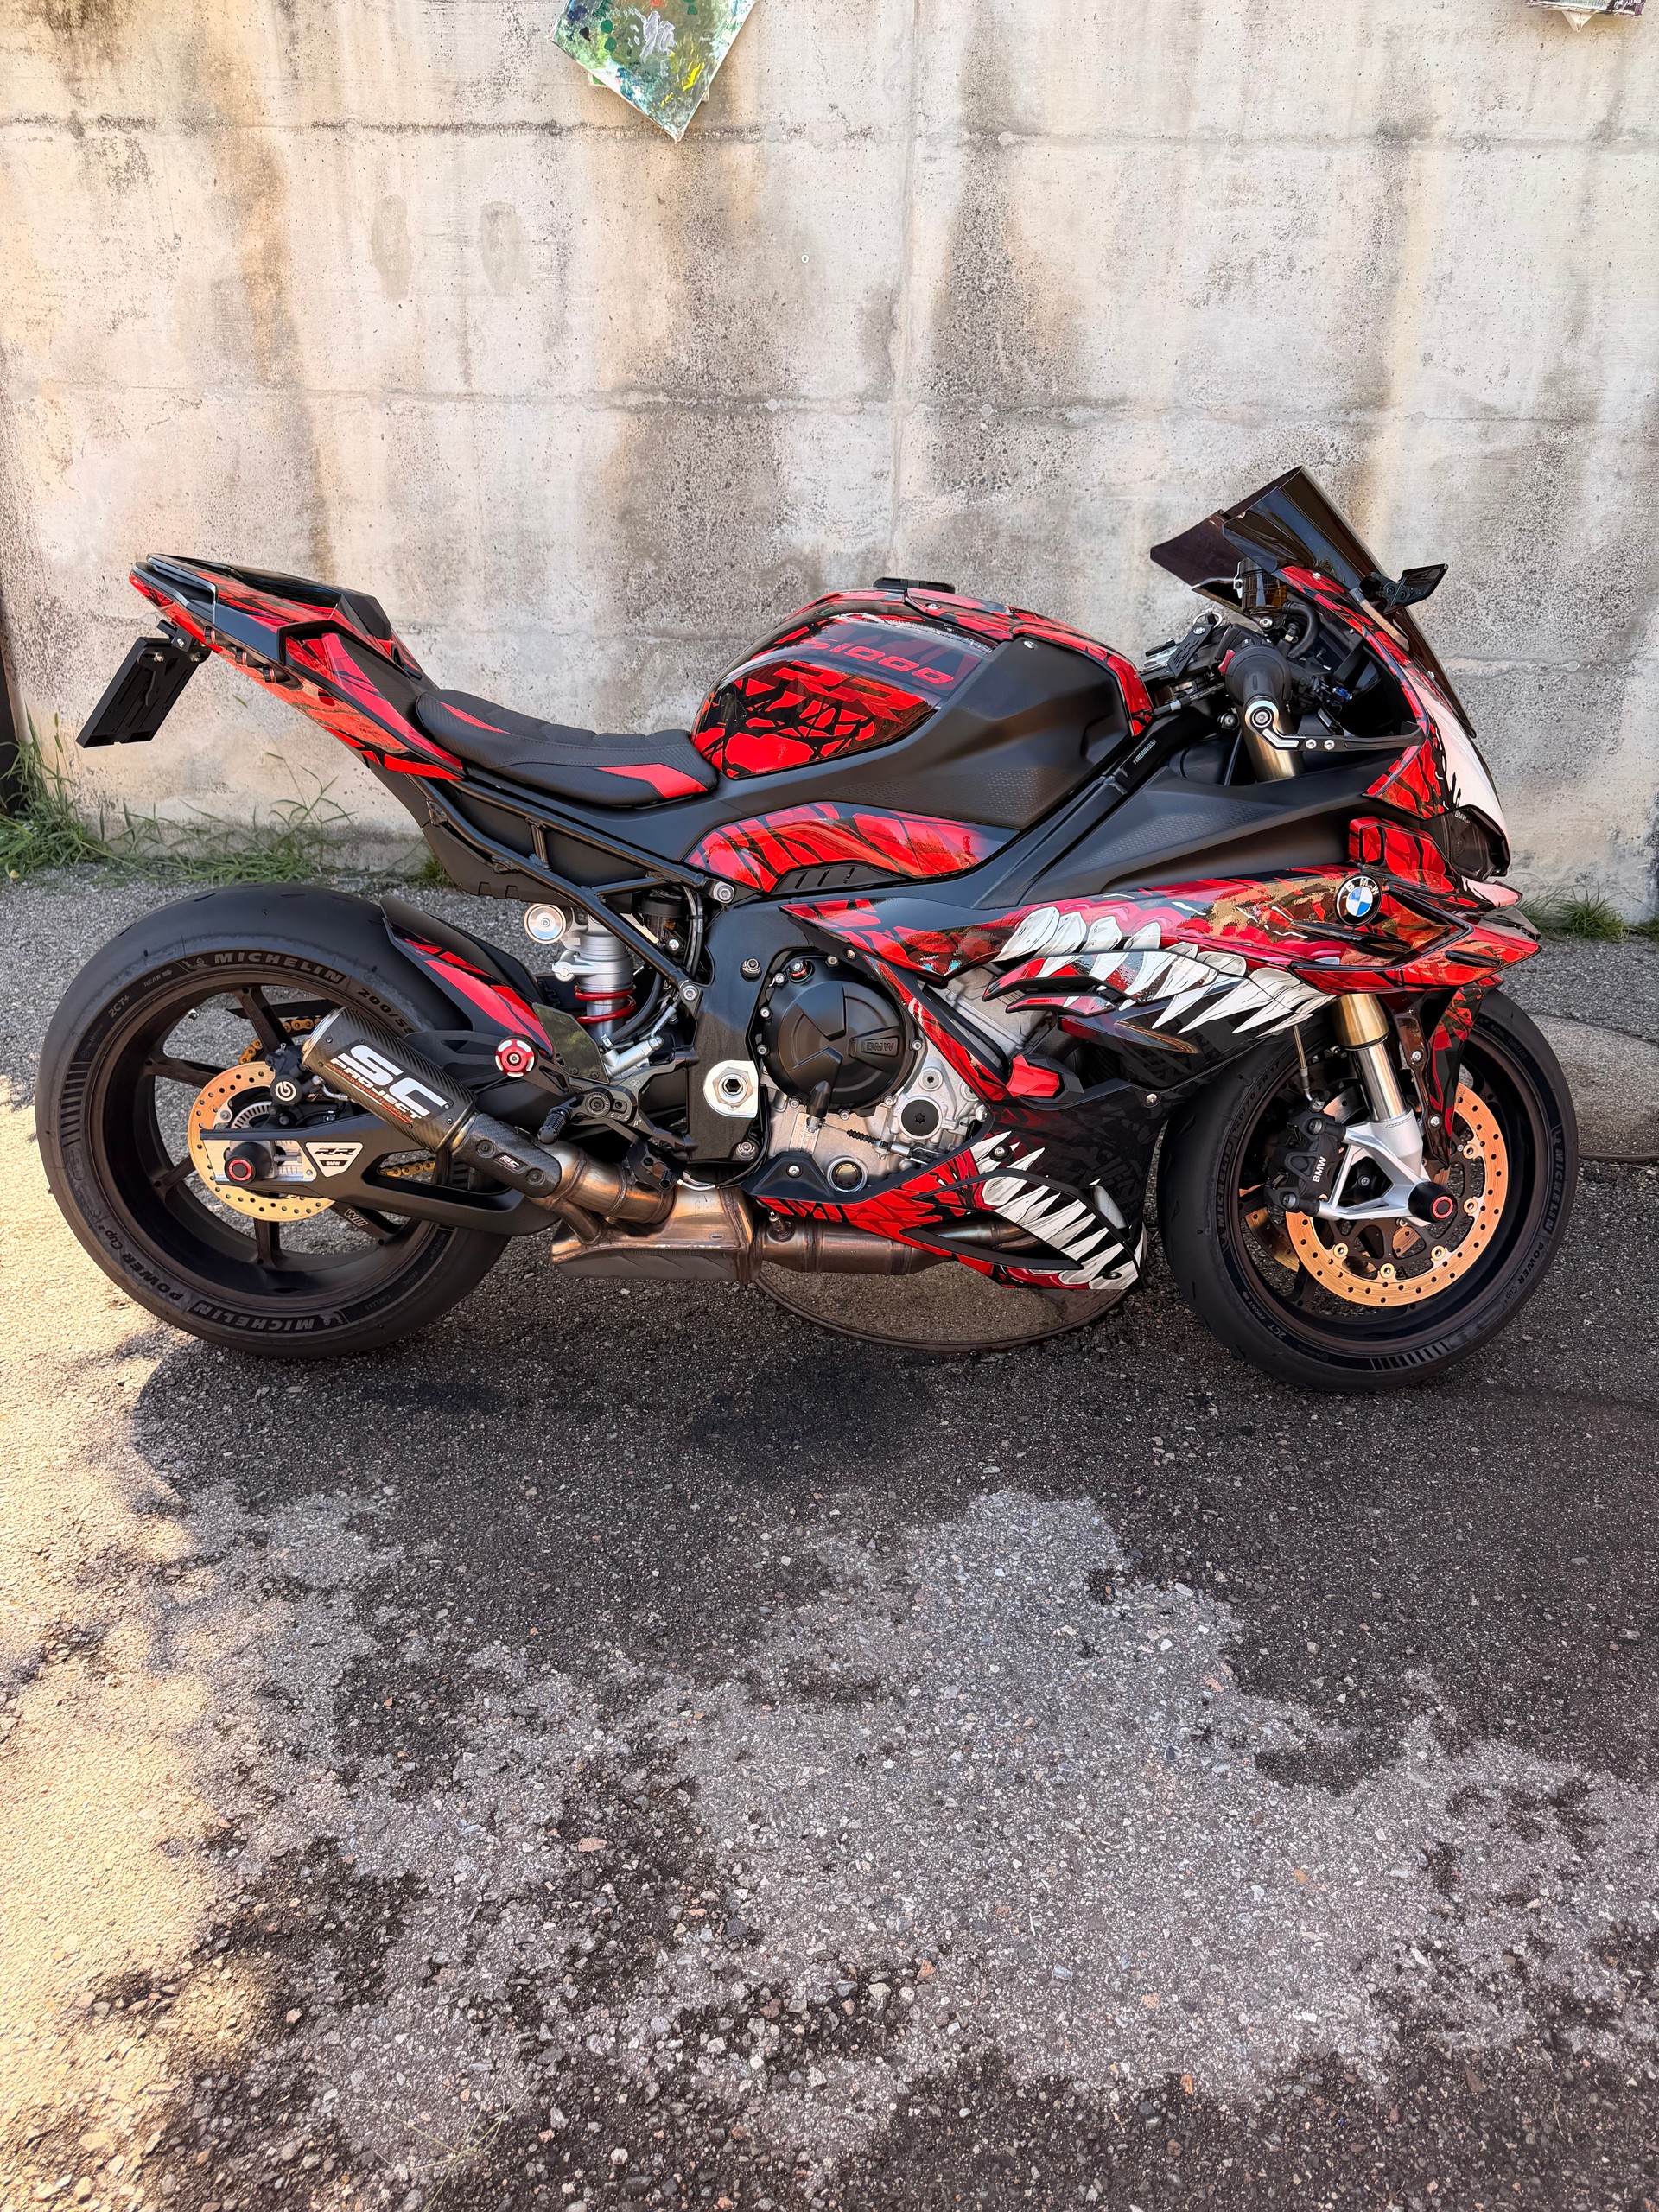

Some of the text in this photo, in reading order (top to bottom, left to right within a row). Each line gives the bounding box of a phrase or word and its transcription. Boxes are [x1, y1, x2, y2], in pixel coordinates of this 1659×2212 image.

[1346, 878, 1379, 896] BMW
[143, 975, 162, 988] REAR
[214, 952, 344, 983] MICHELIN
[108, 995, 130, 1018] 2CT+
[867, 1042, 894, 1052] BMW
[325, 1062, 415, 1122] ADVANCED EXHAUST TECHNOLOGY
[330, 1058, 422, 1120] PROJECT
[337, 1045, 448, 1117] SC
[1232, 1092, 1255, 1133] 120/70
[1217, 1141, 1233, 1228] MICHELIN
[1313, 1156, 1327, 1183] BMW
[1545, 1148, 1564, 1232] MICHELIN
[122, 1253, 184, 1301] POWER
[1518, 1242, 1544, 1285] POWER
[193, 1301, 315, 1332] MICHELIN
[1248, 1300, 1265, 1320] FRONT
[1268, 1324, 1287, 1339] 2CT
